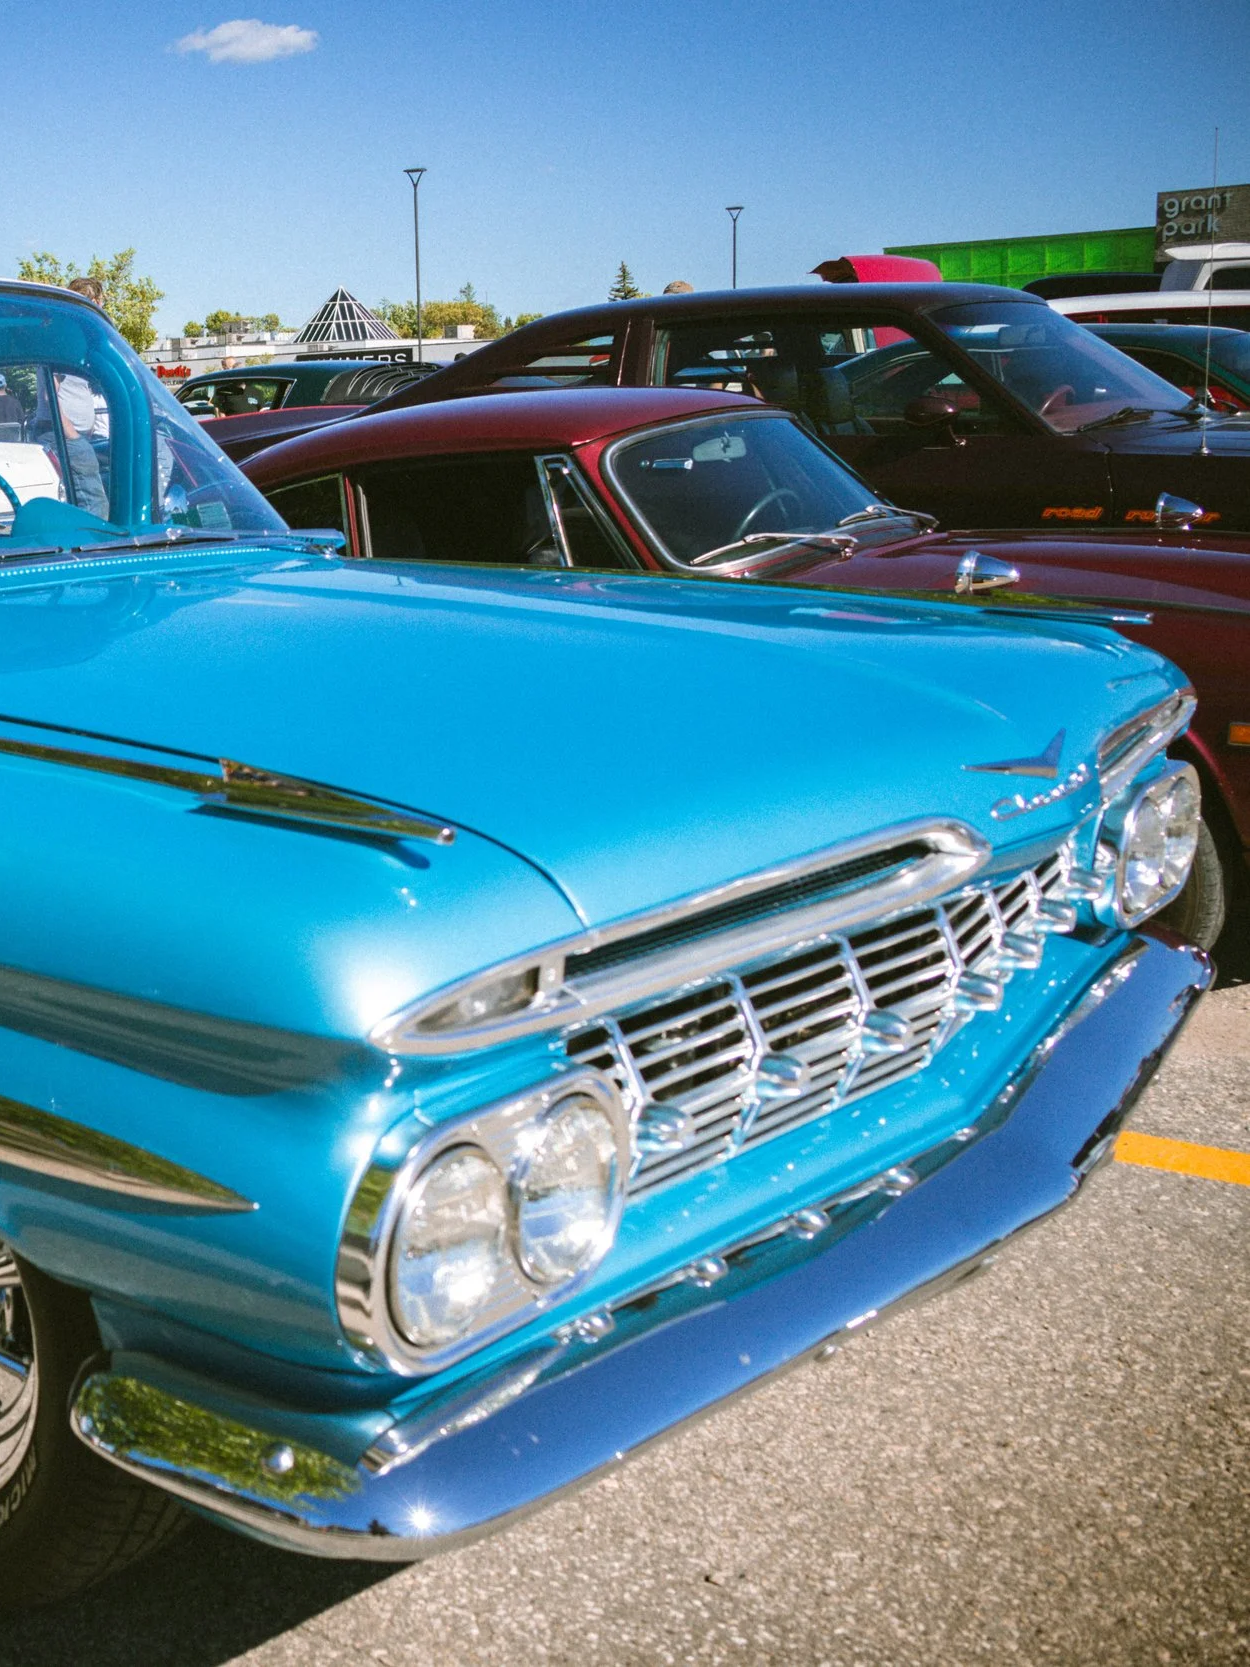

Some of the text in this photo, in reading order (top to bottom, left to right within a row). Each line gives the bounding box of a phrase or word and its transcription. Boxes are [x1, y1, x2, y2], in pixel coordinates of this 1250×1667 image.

[1163, 192, 1233, 219] grant
[1161, 213, 1222, 242] park
[1041, 506, 1103, 521] road
